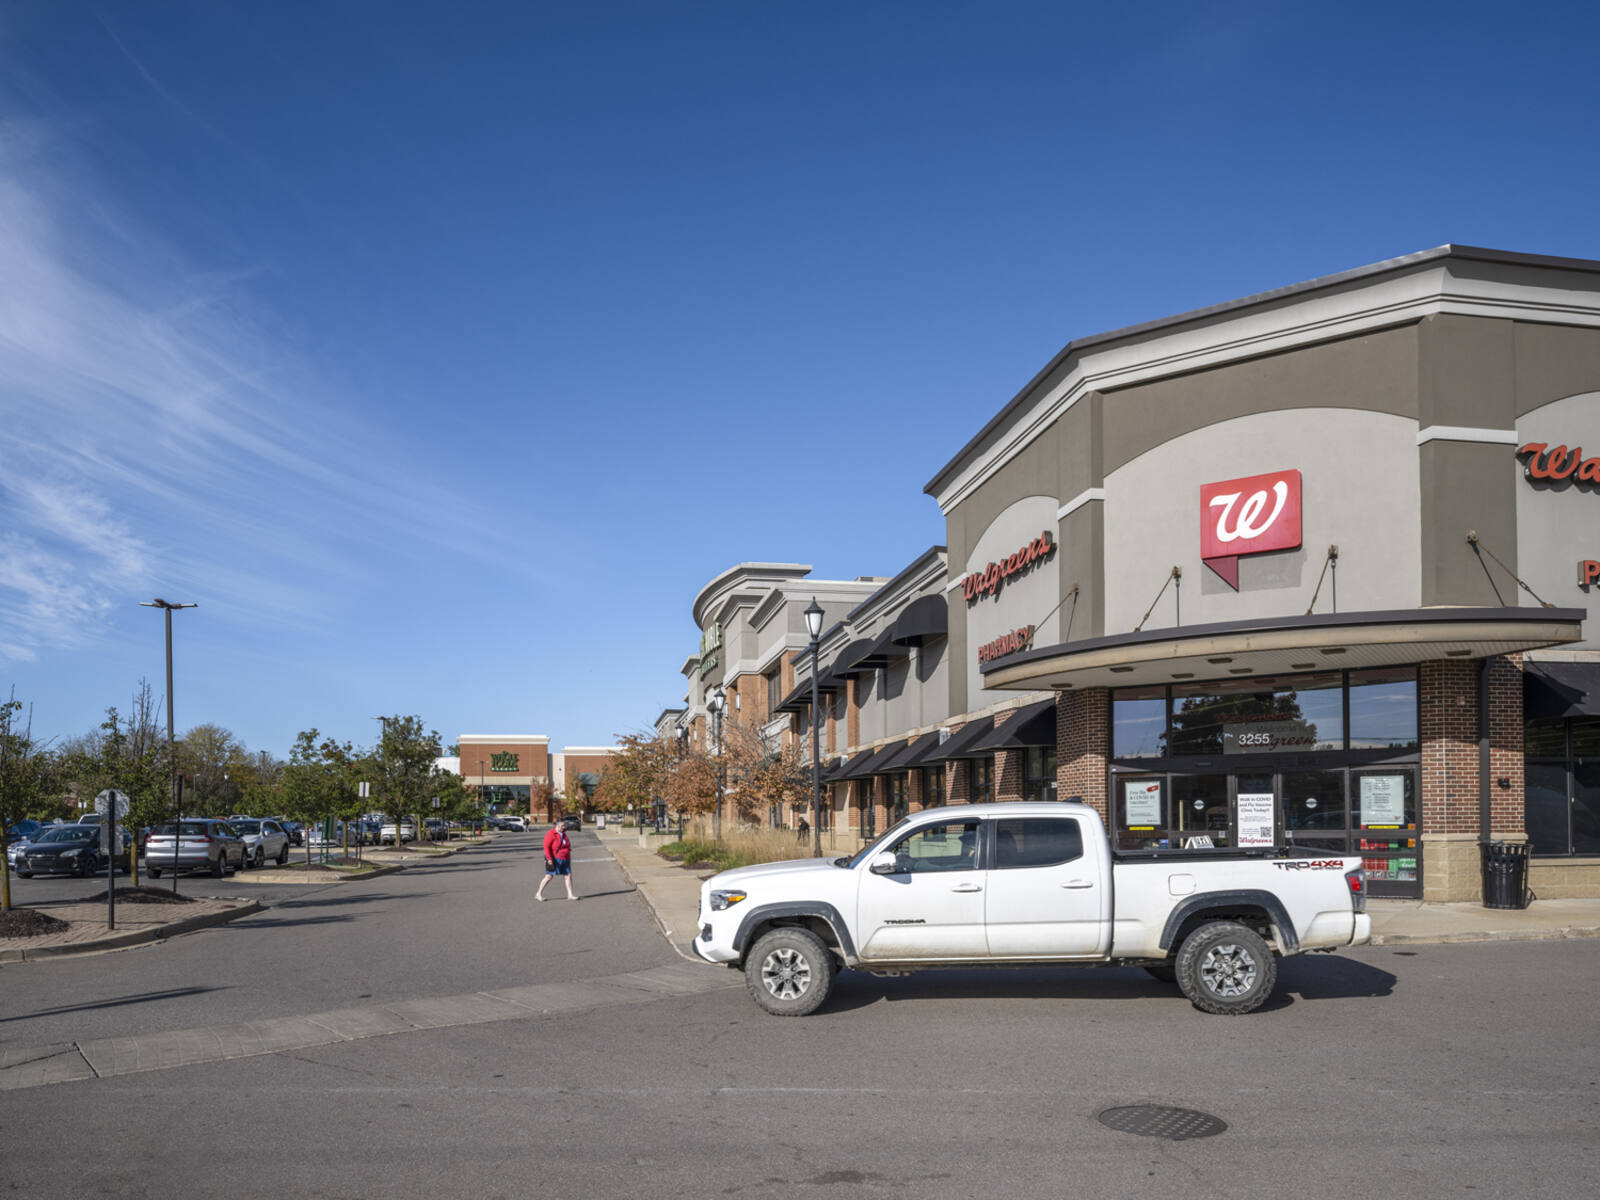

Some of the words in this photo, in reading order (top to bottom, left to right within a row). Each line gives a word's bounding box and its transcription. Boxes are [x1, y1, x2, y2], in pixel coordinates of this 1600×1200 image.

[1208, 480, 1288, 543] W
[960, 530, 1054, 601] Walgreens
[977, 624, 1033, 665] PHARMACY
[1239, 733, 1270, 745] 3255
[1239, 836, 1273, 845] Walgreens
